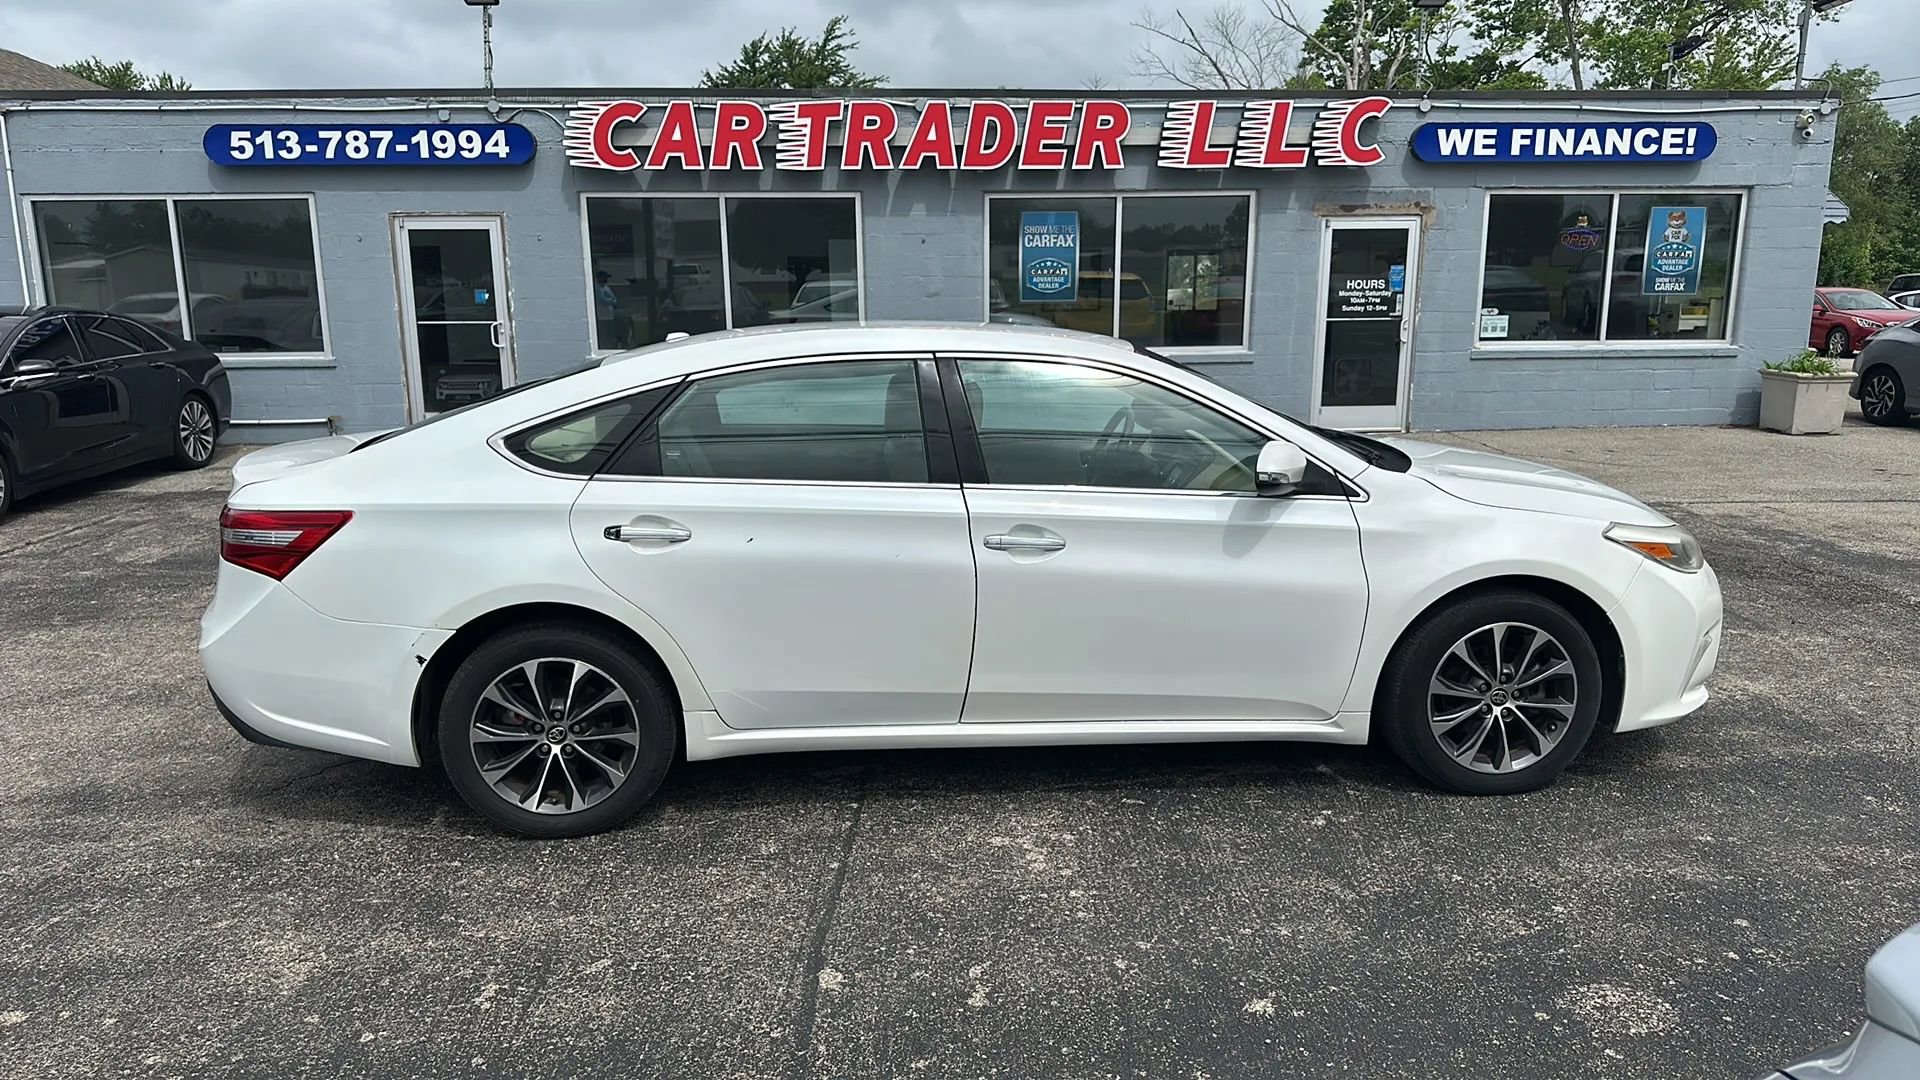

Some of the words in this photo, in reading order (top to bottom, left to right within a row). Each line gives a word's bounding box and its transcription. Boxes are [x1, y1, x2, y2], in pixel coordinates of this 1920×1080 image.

[562, 99, 768, 171] CAR
[769, 99, 1131, 171] TRADER
[1157, 96, 1394, 168] LLC
[229, 129, 510, 160] 513-787-1994
[1437, 128, 1498, 156] WE
[1510, 127, 1697, 156] FINANCE!
[1024, 225, 1048, 234] SHOW
[1024, 234, 1074, 248] CARFAX
[1560, 233, 1598, 246] OPEN
[1346, 279, 1386, 290] HOURS
[1654, 283, 1685, 291] CARFAX
